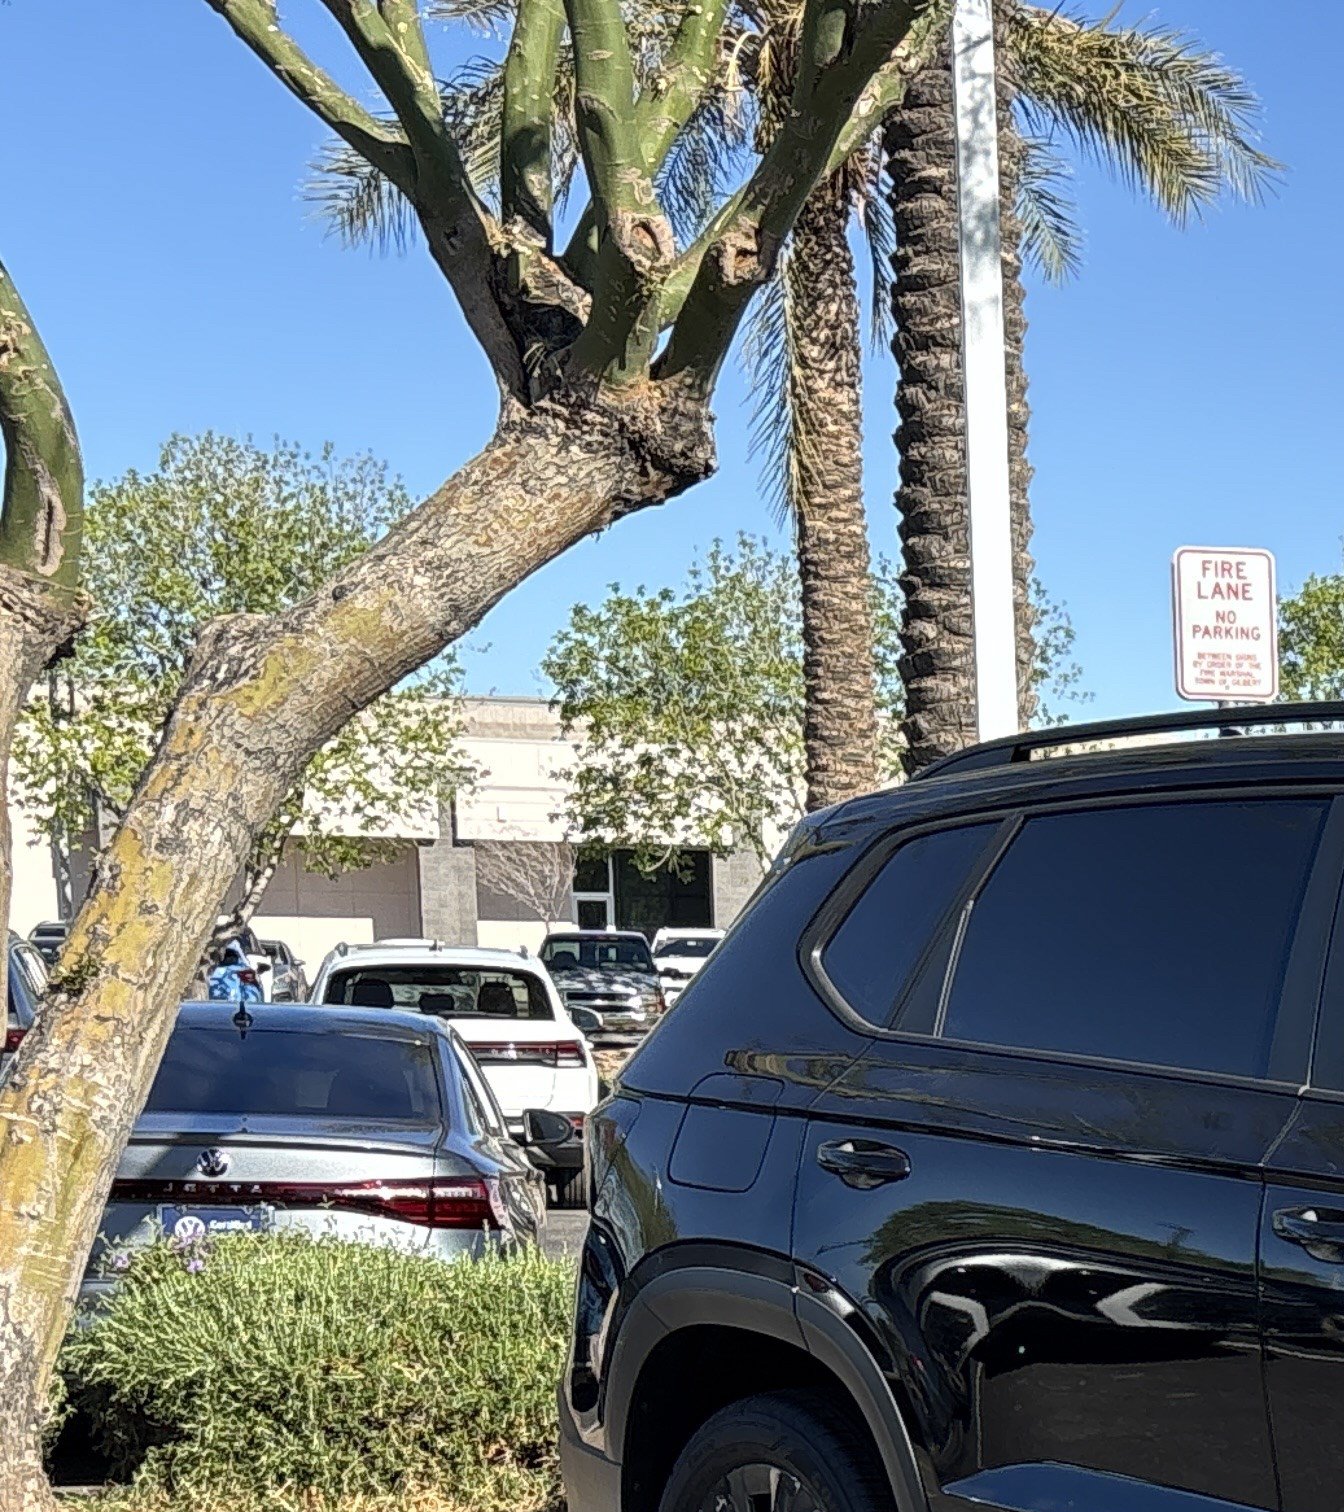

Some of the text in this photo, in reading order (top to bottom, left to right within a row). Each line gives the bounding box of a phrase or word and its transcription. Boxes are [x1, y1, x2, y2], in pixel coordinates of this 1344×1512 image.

[1202, 560, 1247, 580] FIRE
[1197, 581, 1253, 600] LANE
[1216, 610, 1236, 624] NO
[1192, 624, 1261, 641] PARKING
[163, 1182, 262, 1193] JETTA
